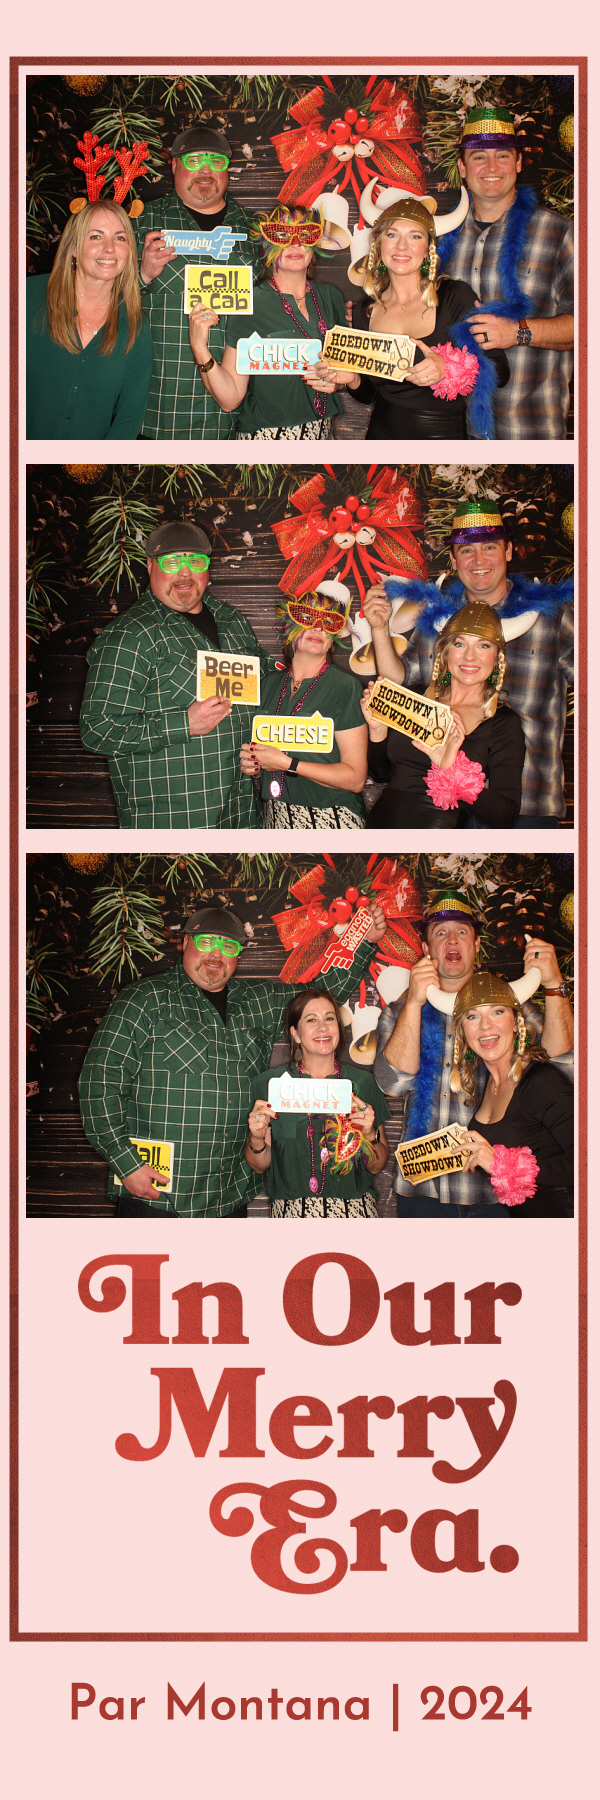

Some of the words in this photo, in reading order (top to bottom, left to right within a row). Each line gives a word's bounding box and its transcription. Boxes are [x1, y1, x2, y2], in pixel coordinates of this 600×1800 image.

[164, 235, 216, 251] Naughty
[199, 270, 238, 290] Call
[210, 293, 248, 311] Cab
[248, 344, 310, 362] CHICK
[330, 333, 393, 354] HOEDOWN
[249, 362, 310, 371] MAGNET
[324, 346, 396, 377] SHOWDOWN
[204, 655, 253, 679] Beer
[215, 677, 244, 699] Me
[377, 685, 433, 719] HOEDOWN
[369, 696, 431, 742] SHOWDOWN
[256, 723, 329, 744] CHEESE
[340, 910, 368, 947] eggnog
[346, 915, 372, 952] WASTED
[280, 1083, 341, 1102] CHICK
[280, 1100, 340, 1110] MAGNET
[133, 1144, 161, 1166] all
[400, 1134, 450, 1164] HOEDOWN
[402, 1154, 463, 1177] SHOWDOWN
